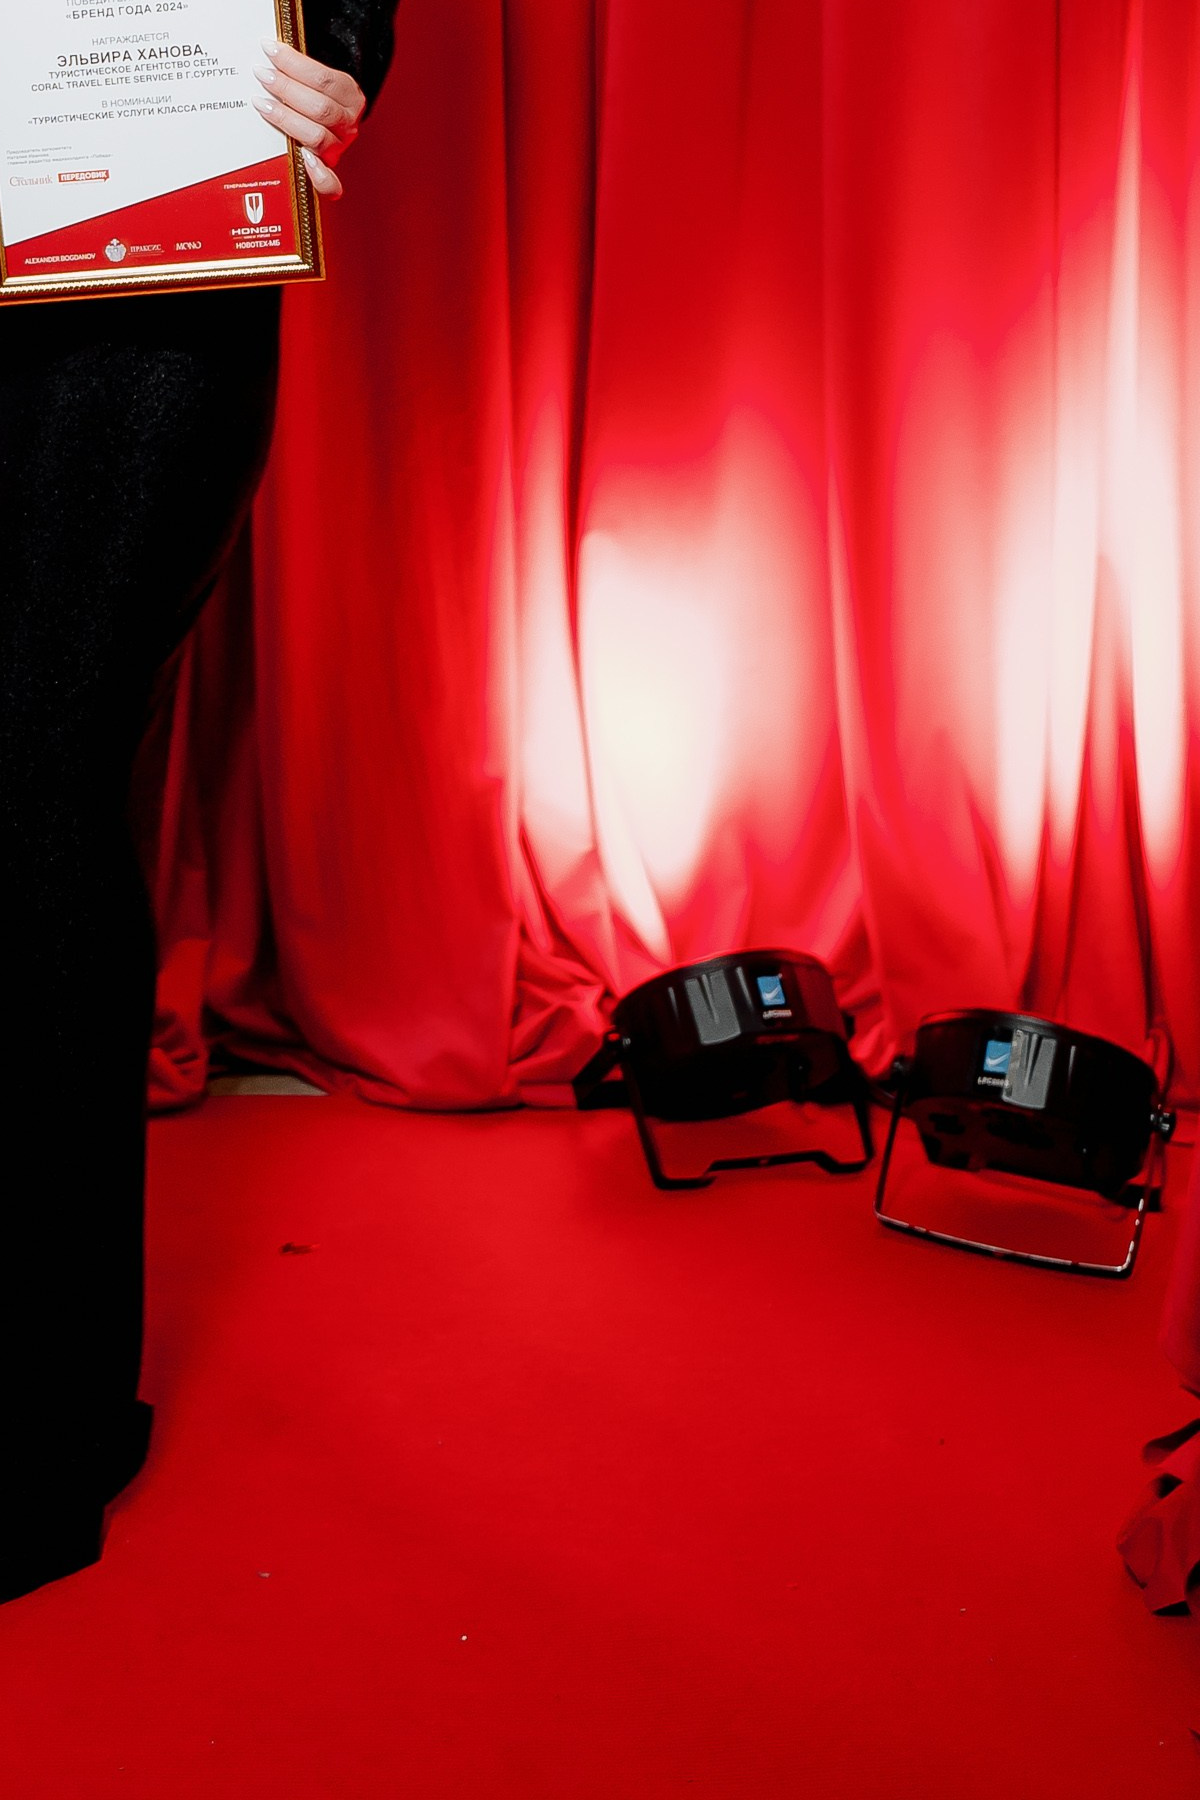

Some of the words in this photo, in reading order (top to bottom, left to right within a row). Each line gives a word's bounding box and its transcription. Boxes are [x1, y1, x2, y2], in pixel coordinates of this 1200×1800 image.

[65, 6, 115, 20] «БРЕНД
[118, 4, 152, 17] ГОДА
[155, 1, 189, 13] 2024»
[91, 32, 170, 47] НАГРАЖДАЕТСЯ
[56, 49, 133, 68] ЭЛЬВИРА
[137, 43, 208, 61] ХАНОВА,
[48, 64, 132, 80] ТУРИСТИЧЕСКОЕ
[134, 60, 191, 73] АГЕНТСТВО
[193, 57, 219, 68] СЕТИ
[30, 82, 65, 92] CORAL
[66, 78, 103, 89] TRAVEL
[104, 76, 132, 86] ELITE
[133, 72, 175, 84] SERVICE
[176, 71, 184, 80] В
[101, 99, 109, 109] В
[110, 95, 173, 108] НОМИНАЦИИ
[27, 110, 115, 125] «ТУРИСТИЧЕСКИЕ
[116, 107, 156, 118] УСЛУГИ
[157, 104, 198, 115] КЛАССА
[61, 171, 108, 181] ПЕРЕДОВИК
[231, 225, 282, 236] HONGQI
[24, 254, 60, 264] ALEXANDER
[60, 253, 96, 261] BOGDANOV
